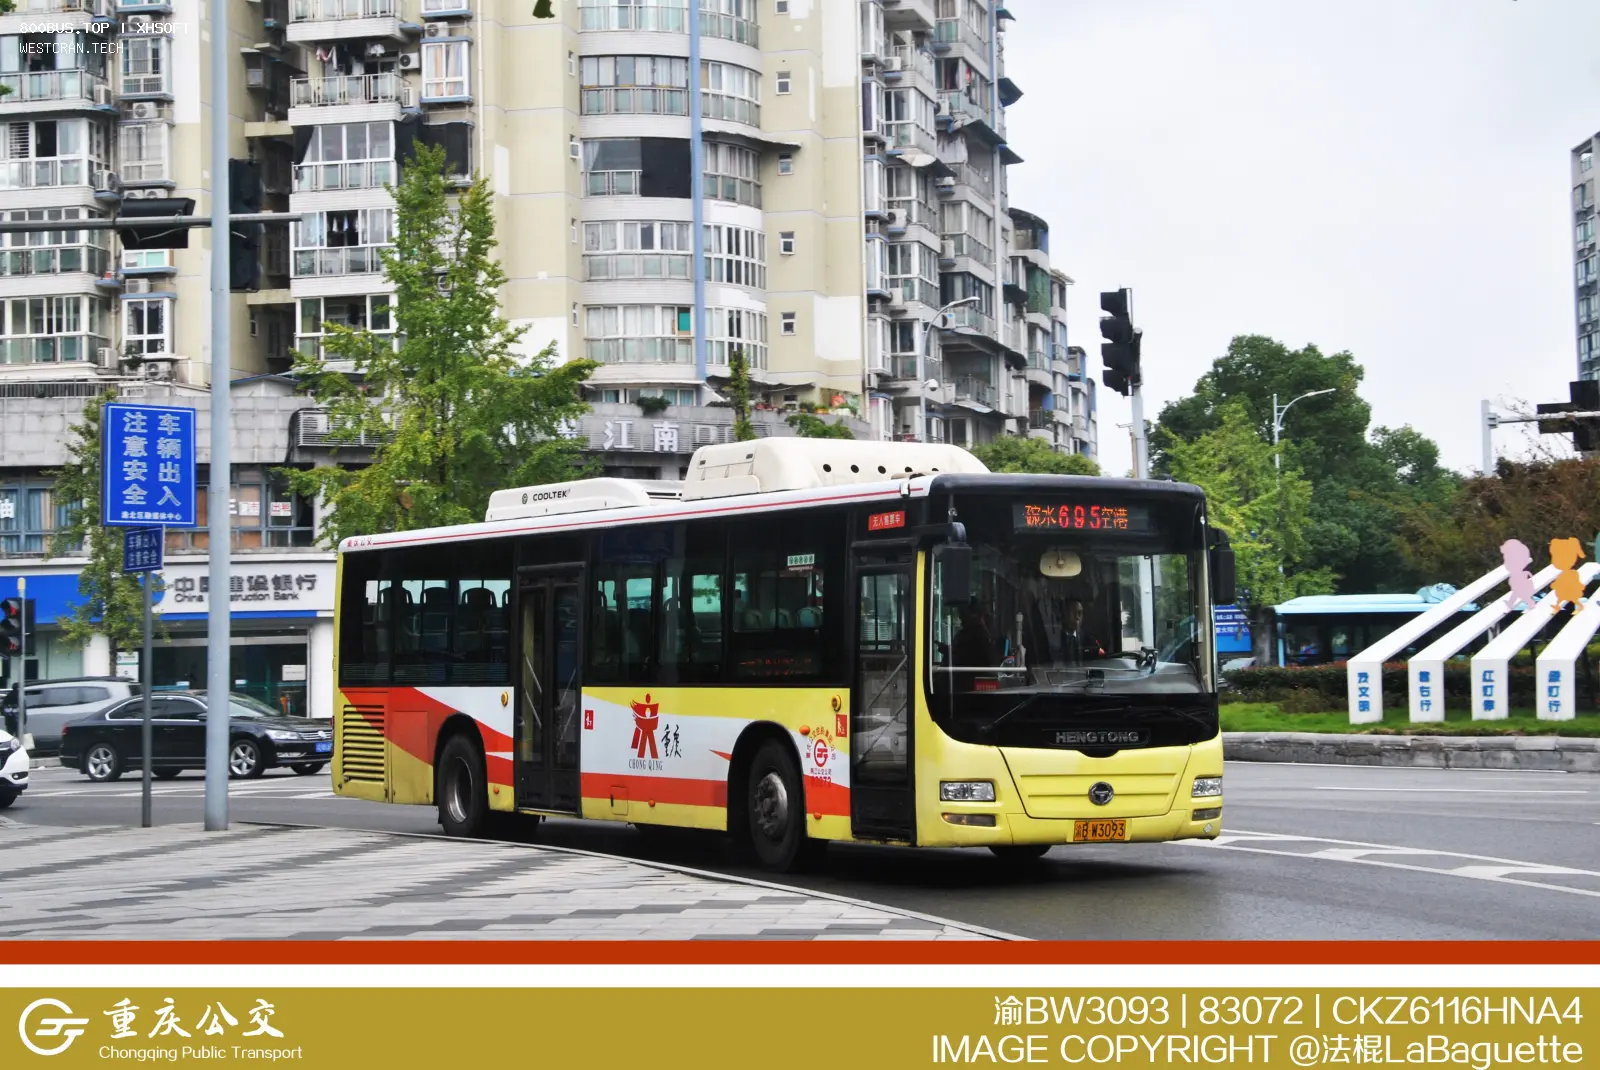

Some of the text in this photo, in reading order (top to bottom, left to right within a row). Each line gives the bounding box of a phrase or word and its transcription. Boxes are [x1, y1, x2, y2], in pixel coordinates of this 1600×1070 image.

[122, 411, 148, 505] 注意安全
[156, 413, 182, 507] 车辆出入
[532, 490, 568, 501] COOLTEK
[1058, 504, 1101, 529] 695
[174, 593, 204, 603] China
[273, 590, 300, 601] Bank
[1055, 731, 1140, 744] HENGTONG
[628, 758, 664, 772] CHONG QING
